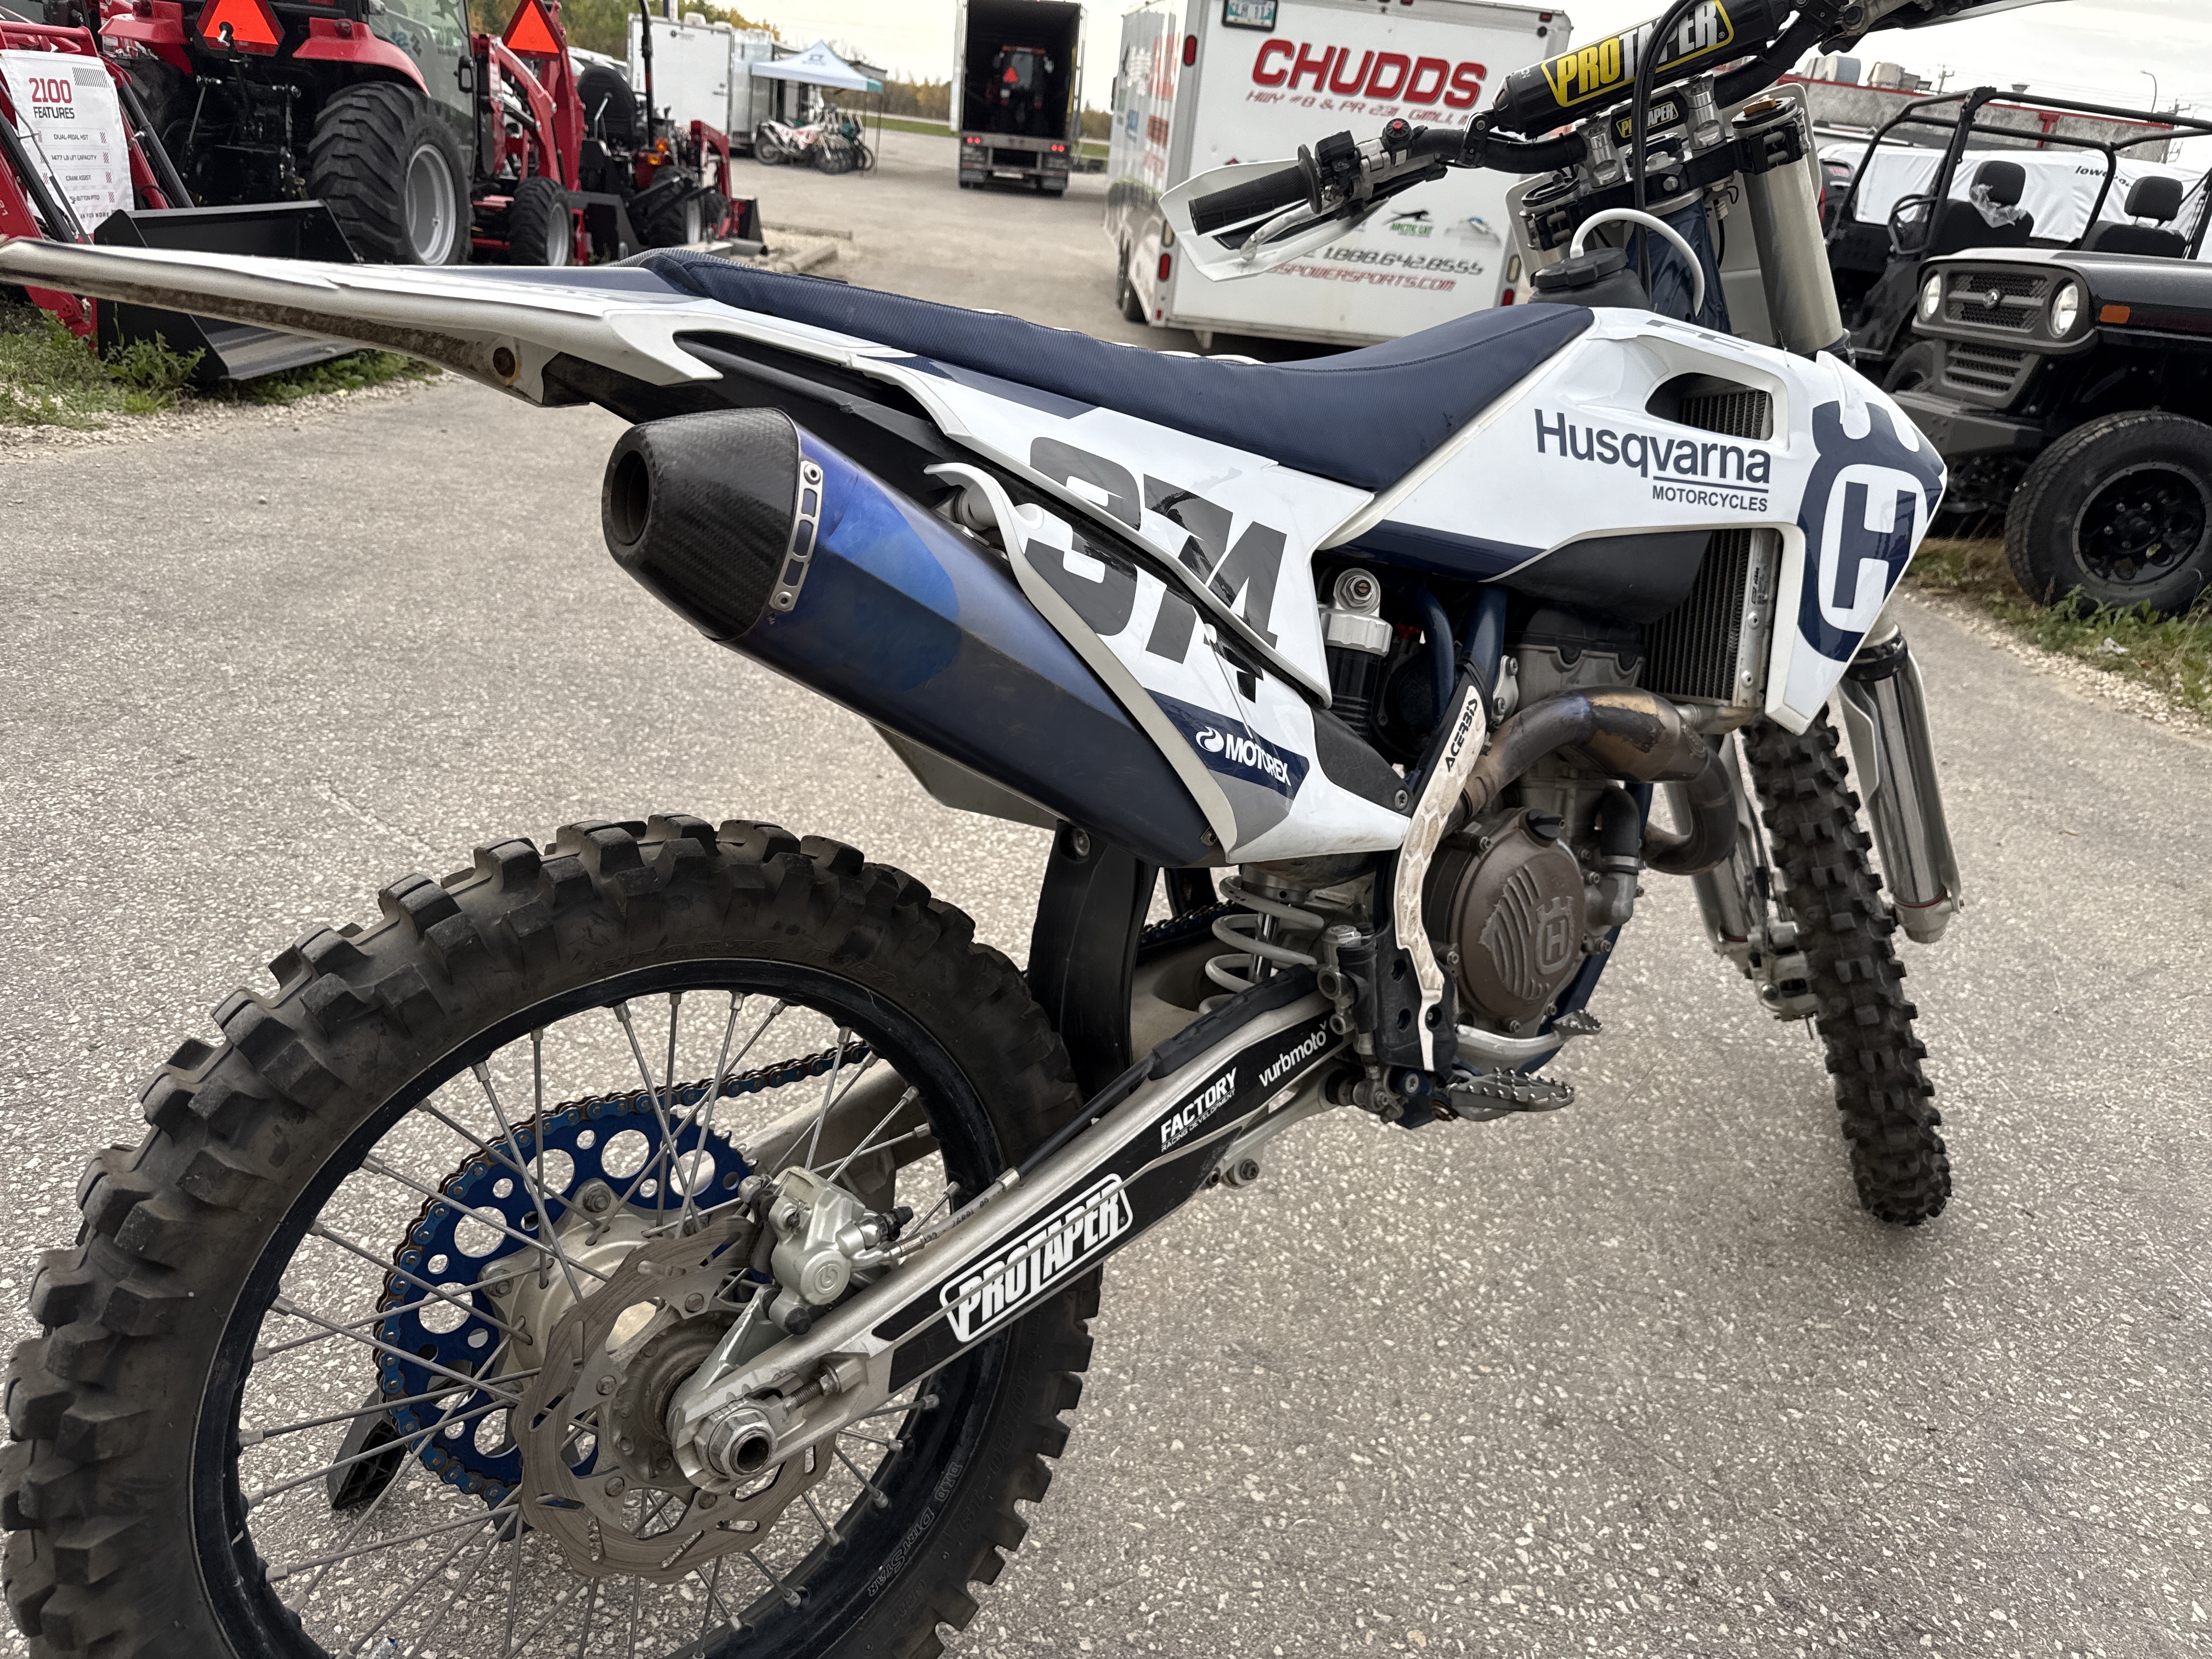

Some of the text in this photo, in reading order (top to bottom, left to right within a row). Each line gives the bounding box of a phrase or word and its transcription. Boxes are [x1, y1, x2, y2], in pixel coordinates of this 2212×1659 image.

[29, 77, 72, 103] 2100
[1251, 38, 1487, 109] CHUDDS
[33, 106, 75, 119] FEATURES
[1534, 409, 1770, 484] Husqvarna
[1652, 485, 1768, 512] MOTORCYCLES
[1226, 733, 1291, 786] MOTOREX
[1259, 1030, 1327, 1087] vurbmoto
[1161, 1066, 1237, 1143] FACTORY
[1161, 1088, 1235, 1152] RACING DEVELOPMENT
[959, 1181, 1119, 1339] PROTAPER
